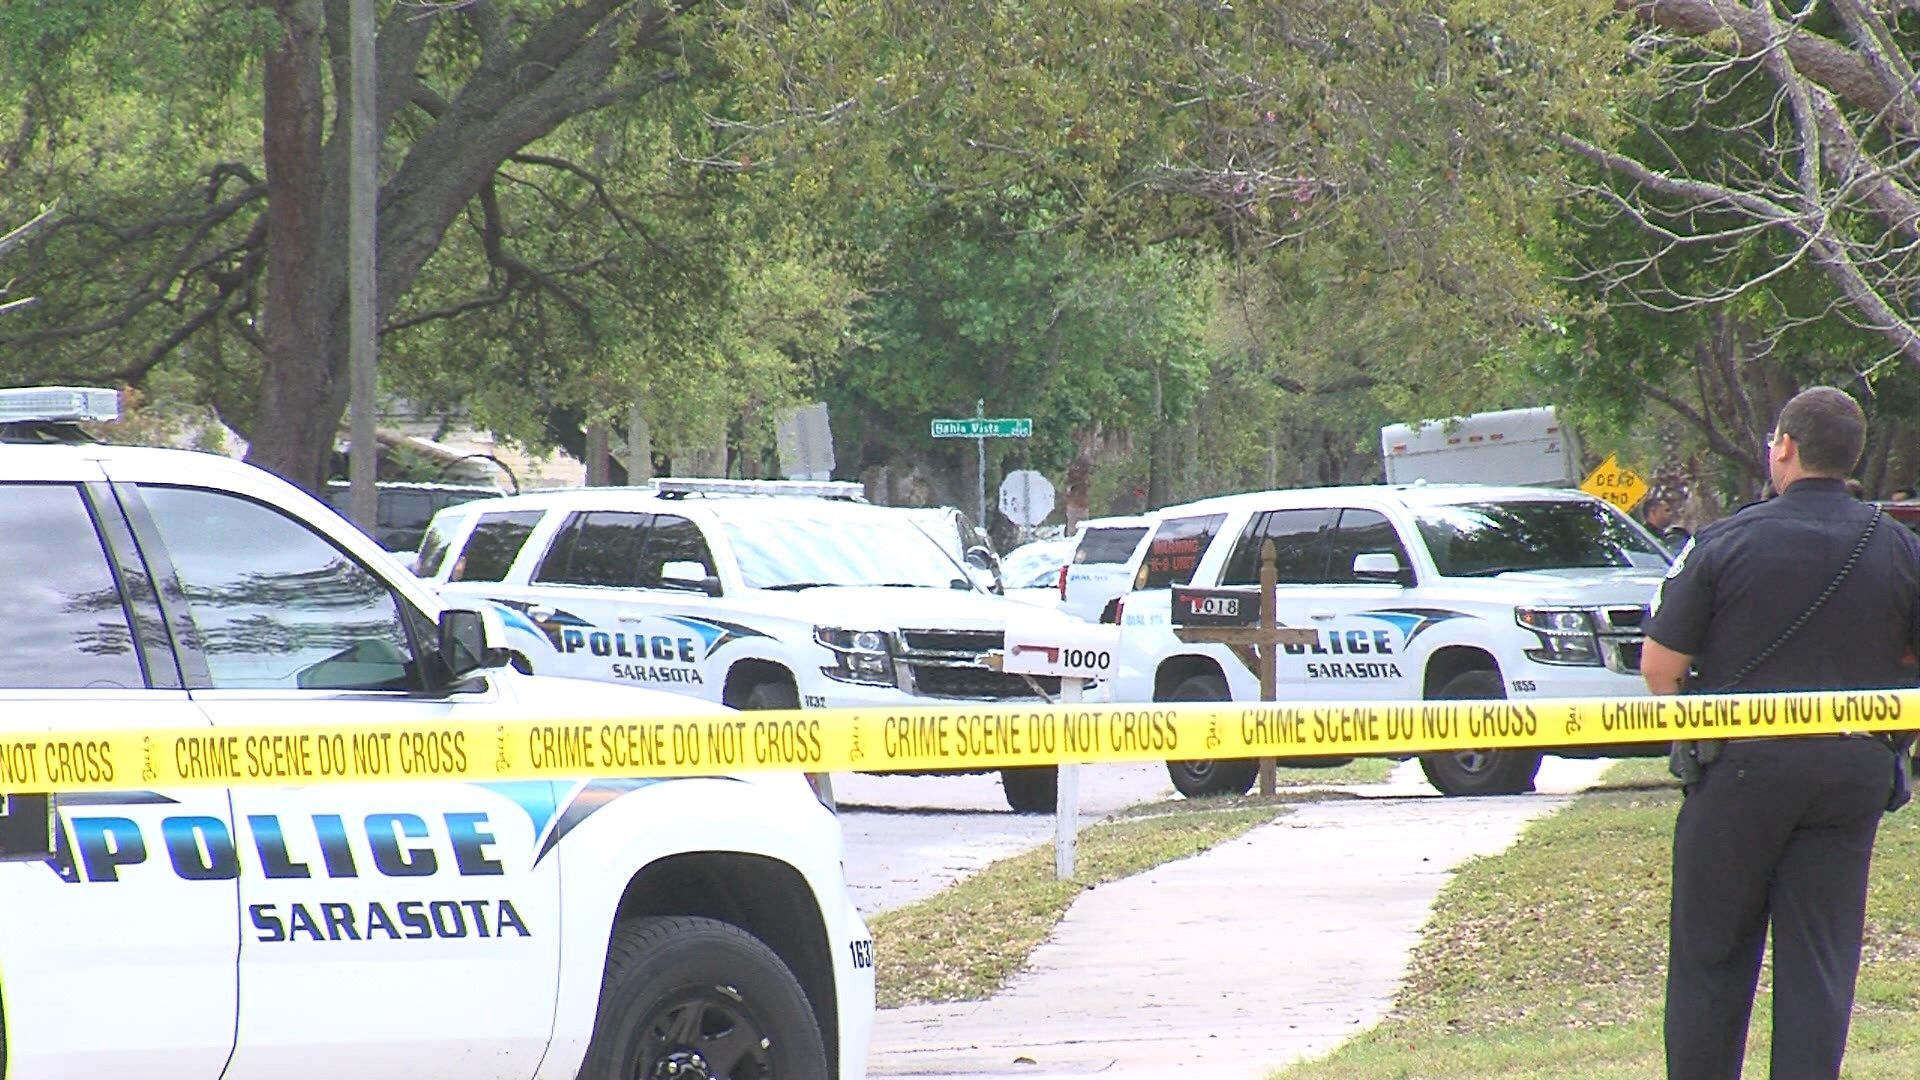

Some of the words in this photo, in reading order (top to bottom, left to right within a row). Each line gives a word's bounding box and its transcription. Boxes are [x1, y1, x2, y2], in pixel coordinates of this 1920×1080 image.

[935, 423, 966, 435] Bahia
[971, 423, 1000, 433] Vista
[1597, 473, 1634, 487] DED
[564, 630, 695, 663] POLICE
[1063, 649, 1111, 669] 1000
[612, 664, 703, 684] SARASOTA
[1307, 662, 1402, 678] SARASOTA
[885, 717, 948, 757] CRIME
[957, 715, 1020, 755] SCENE
[1029, 714, 1054, 753] DO
[1064, 713, 1101, 752] NOT
[1111, 712, 1176, 751] CROSS
[1242, 708, 1305, 744] CRIME
[1314, 707, 1378, 742] SCENE
[1387, 707, 1413, 739] DO
[1422, 705, 1457, 738] NOT
[1469, 704, 1536, 737] CROSS
[0, 743, 36, 783] NOT
[45, 741, 113, 782] CROSS
[176, 737, 240, 778] CRIME
[246, 735, 312, 777] SCENE
[318, 734, 345, 775] DO
[354, 733, 390, 774] NOT
[400, 731, 466, 773] CROSS
[530, 727, 593, 768] CRIME
[601, 725, 665, 766] SCENE
[674, 724, 699, 765] DO
[708, 723, 745, 764] NOT
[755, 720, 820, 763] CROSS
[70, 812, 504, 883] POLICE
[249, 900, 532, 942] SARASOTA
[849, 940, 874, 969] 163
